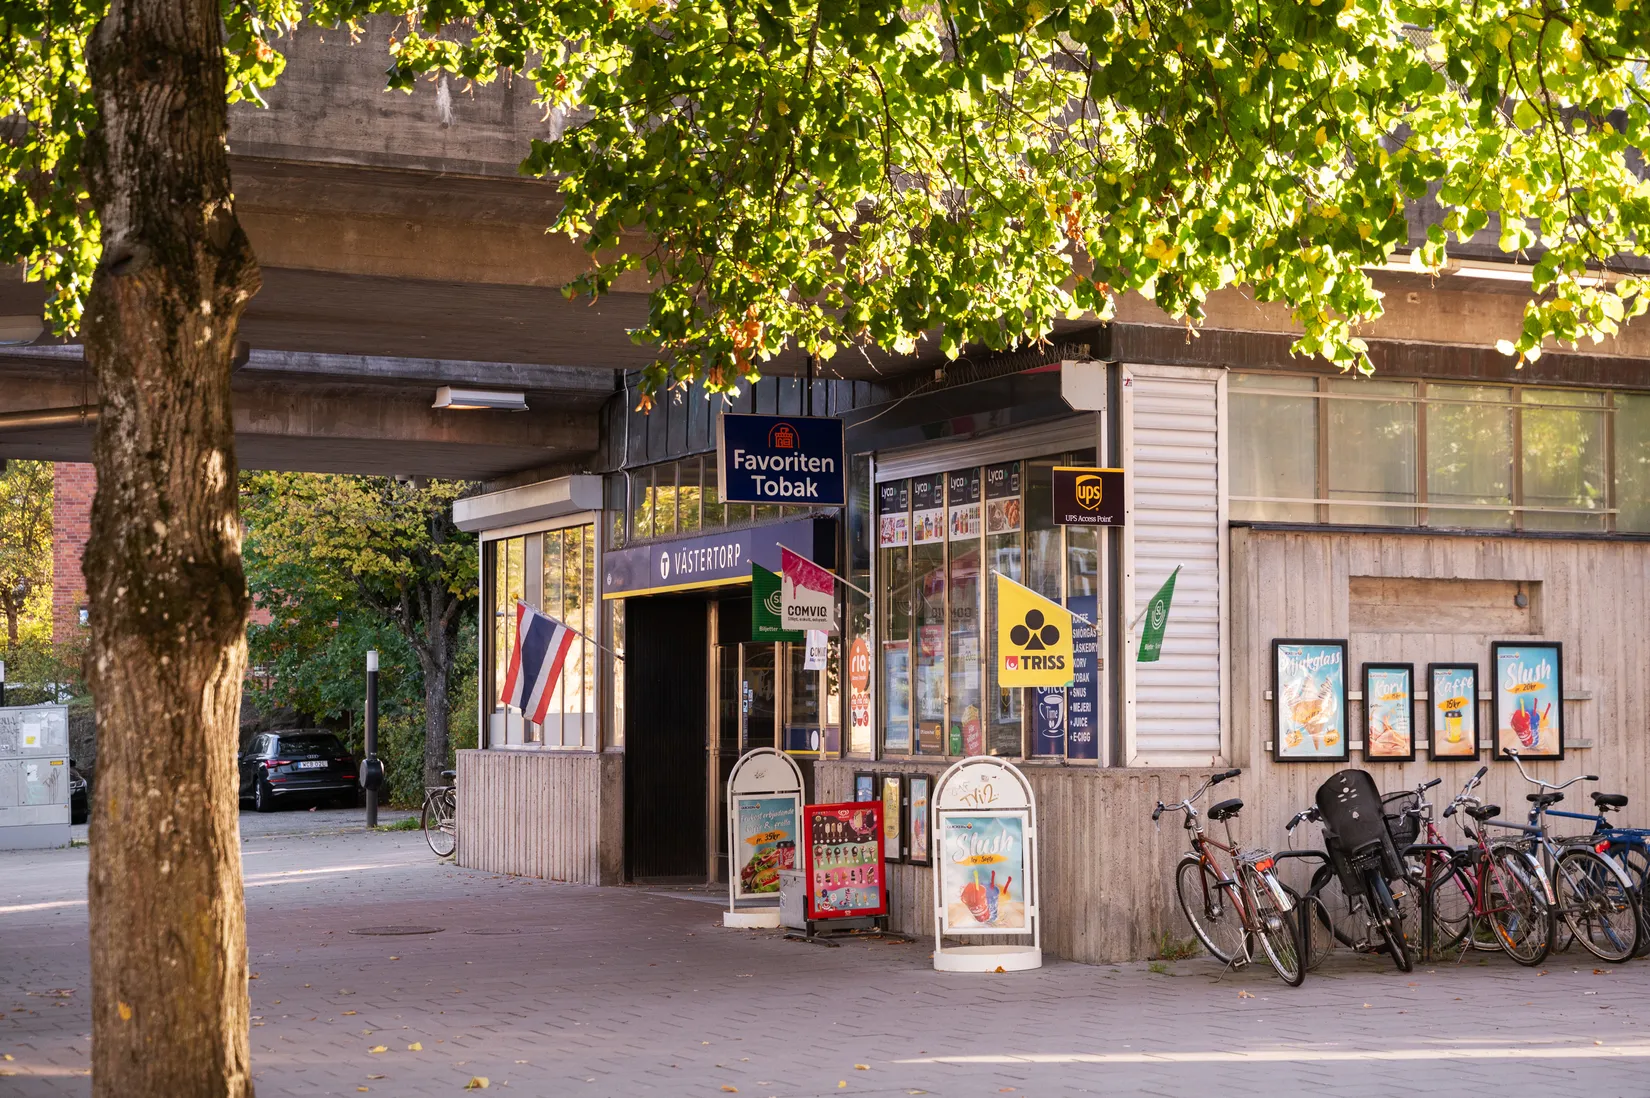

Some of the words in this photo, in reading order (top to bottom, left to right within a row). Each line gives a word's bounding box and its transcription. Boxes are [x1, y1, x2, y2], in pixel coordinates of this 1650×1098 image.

[734, 449, 835, 473] Favoriten
[950, 476, 964, 488] Lyca
[987, 469, 1004, 482] Lyca
[750, 475, 819, 497] Tobak
[881, 486, 894, 499] Lyca
[914, 482, 928, 495] Lyca
[1078, 485, 1100, 504] ups
[1065, 514, 1077, 522] UPS
[1078, 514, 1097, 522] Access
[675, 543, 741, 575] VÄSTERTORP
[788, 605, 828, 617] COMVIQ
[759, 625, 779, 633] Biljetter
[851, 646, 867, 673] ria
[1020, 655, 1066, 671] TRISS
[1073, 672, 1090, 683] TOBAK
[1505, 659, 1551, 690] Slush
[1073, 687, 1087, 698] SNUS
[1374, 679, 1402, 697] Korv
[1434, 675, 1474, 697] Kaffe
[1073, 702, 1092, 713] MEJERI
[1073, 717, 1088, 728] JUICE
[1073, 732, 1091, 743] E-CIGG
[952, 829, 1014, 863] Slush
